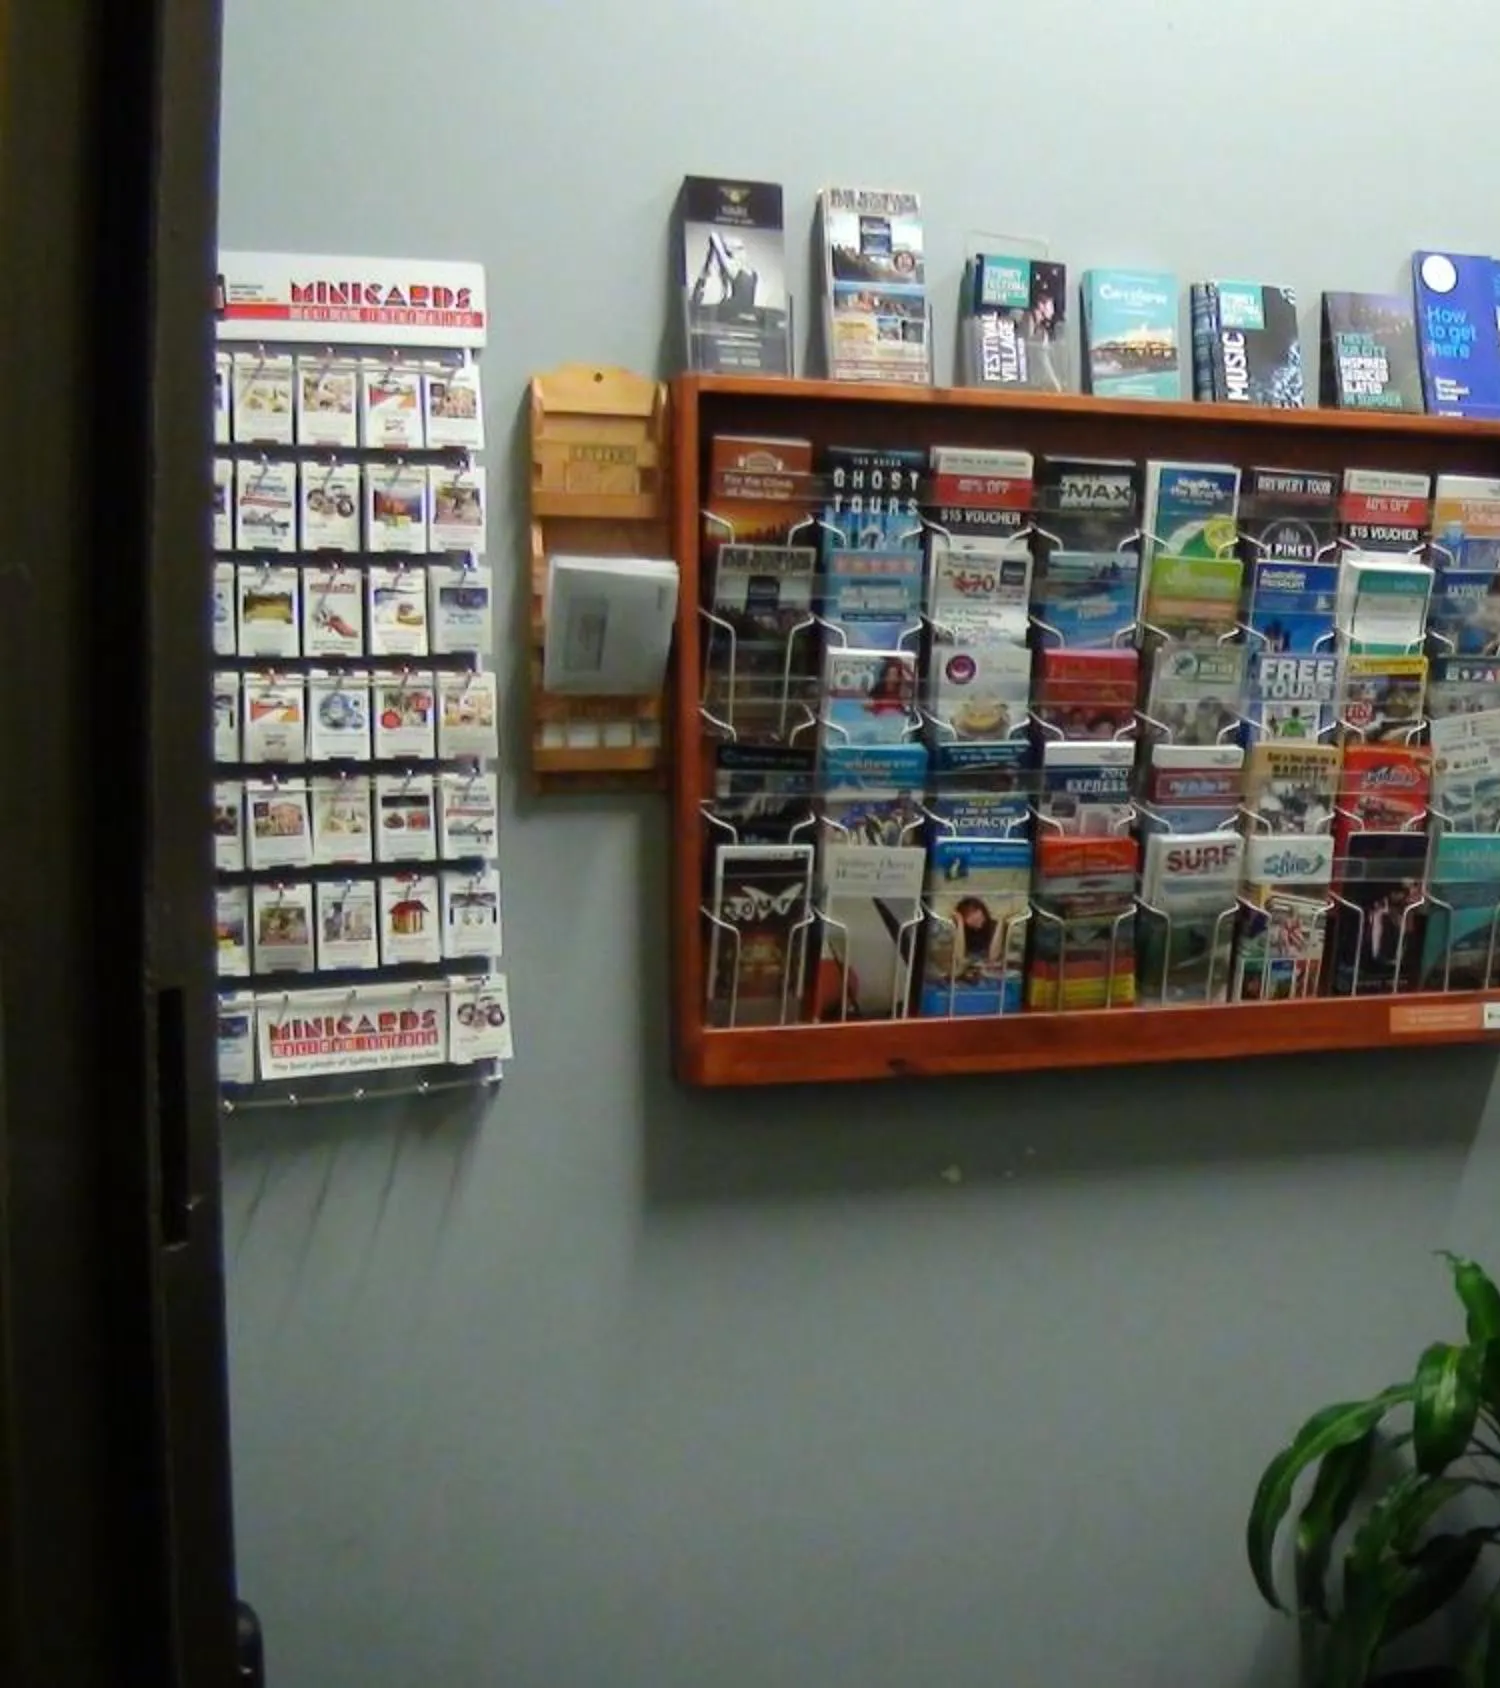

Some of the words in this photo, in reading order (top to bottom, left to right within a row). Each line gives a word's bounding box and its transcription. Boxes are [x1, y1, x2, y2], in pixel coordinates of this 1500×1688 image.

[290, 281, 473, 309] MINICARDS
[1427, 305, 1467, 325] How
[1428, 325, 1446, 341] to
[1448, 326, 1476, 346] get
[1427, 340, 1470, 359] here
[1222, 331, 1250, 401] MUSIC
[833, 468, 920, 491] GHOST
[987, 479, 1011, 494] OFF
[1257, 476, 1304, 493] BREWERY
[1306, 479, 1333, 495] TOUR
[833, 494, 920, 516] TOURS
[1390, 499, 1411, 513] OFF
[965, 509, 1022, 526] VOUCHER
[1370, 526, 1420, 541] VOUCHER
[1259, 658, 1336, 683] FREE
[1262, 682, 1332, 699] TOURS
[1167, 845, 1237, 873] SURF
[268, 1008, 438, 1041] MINICARDS
